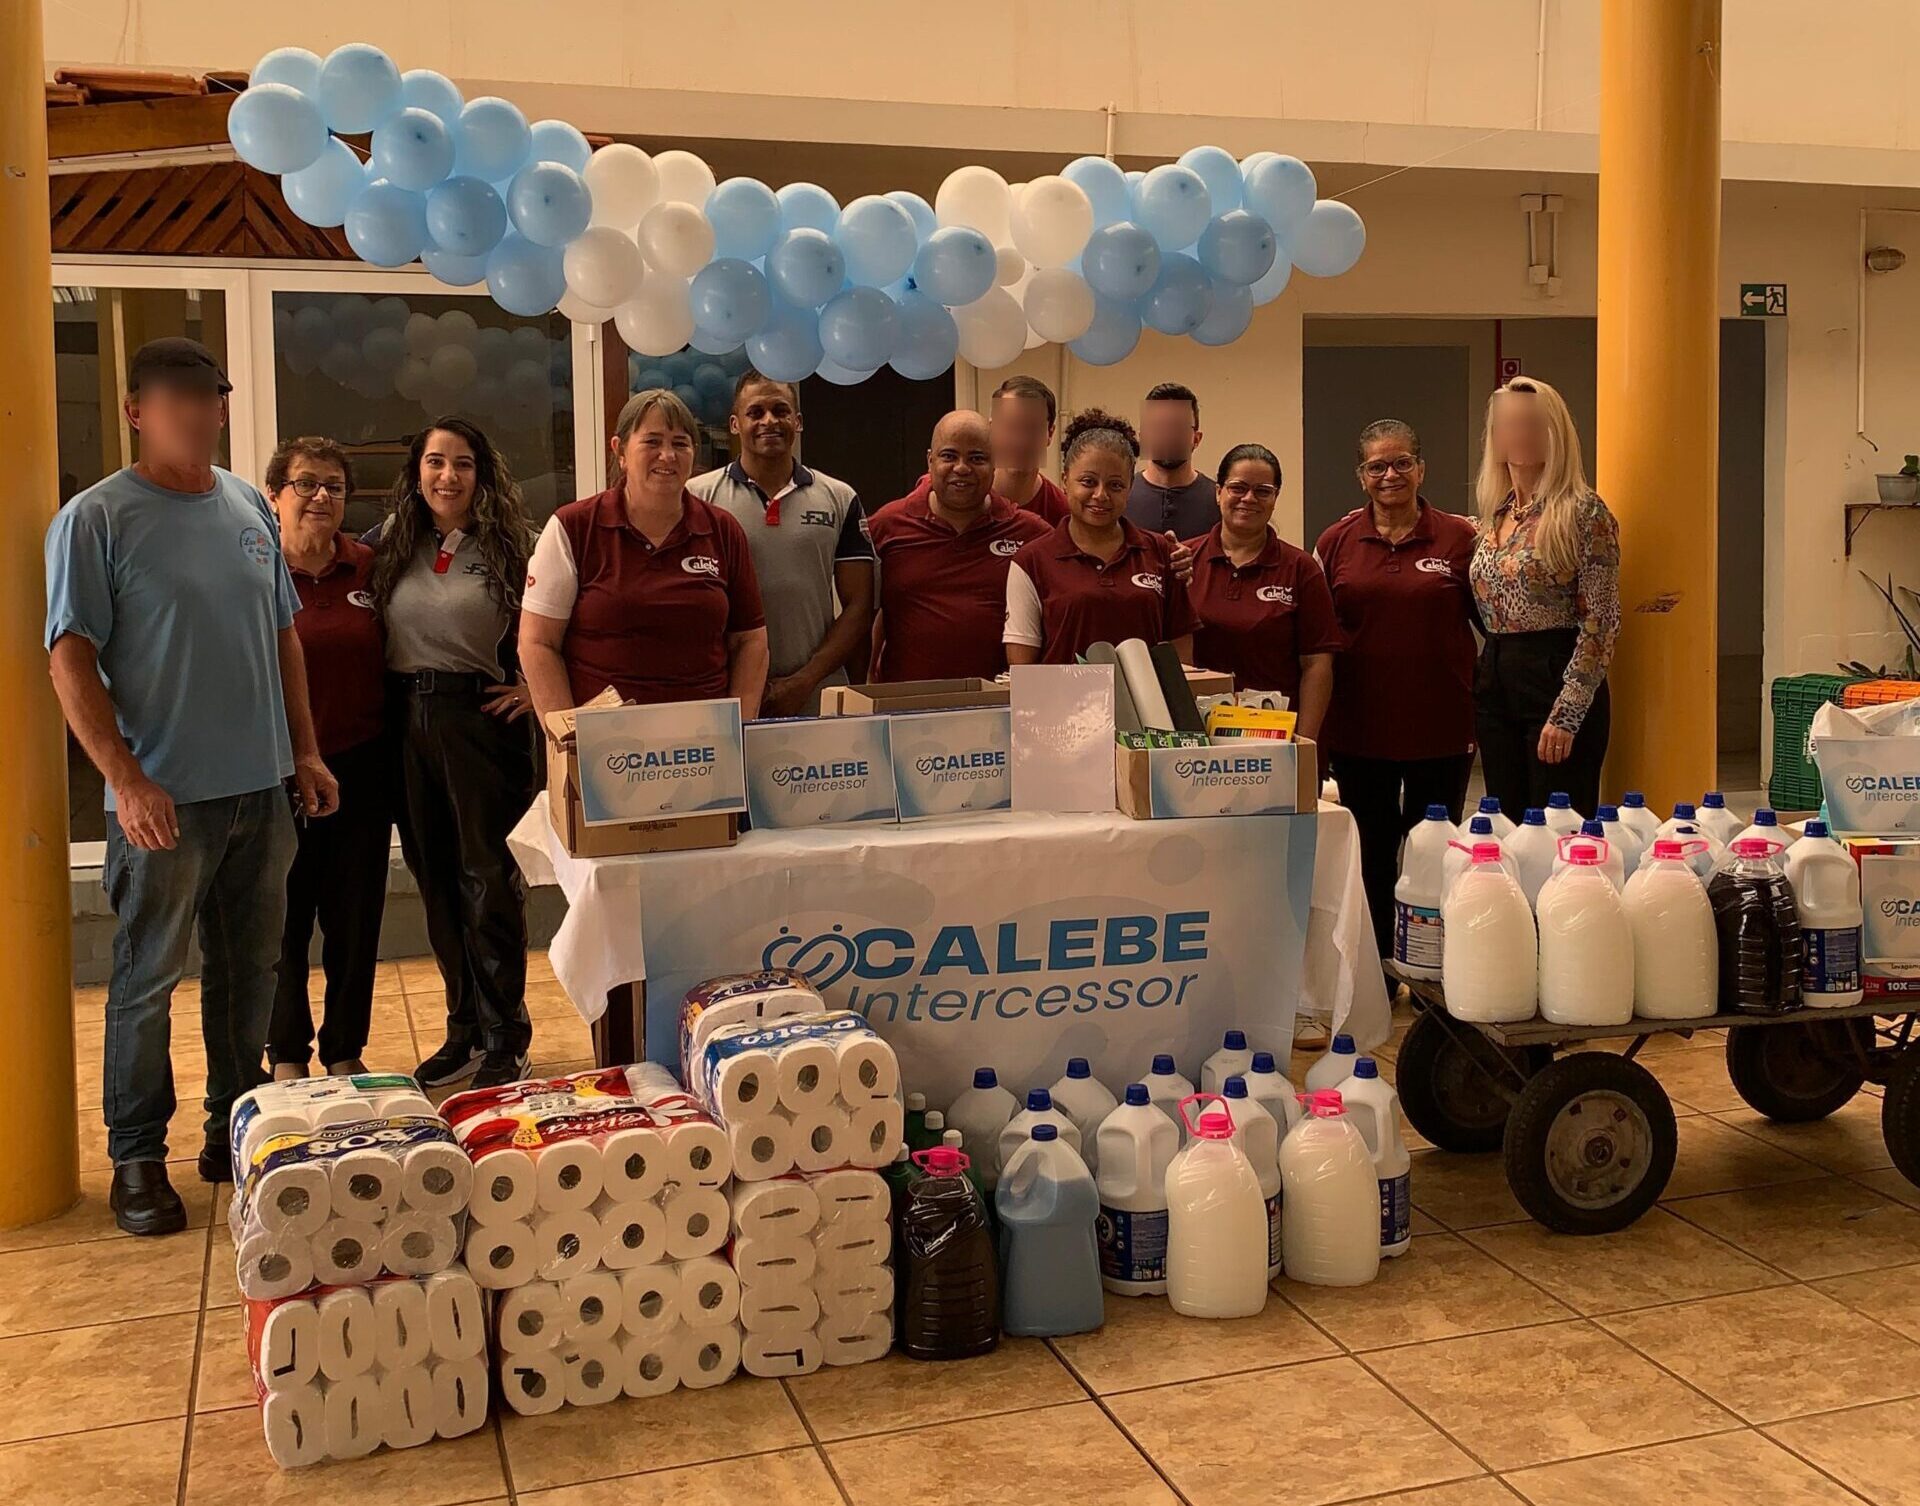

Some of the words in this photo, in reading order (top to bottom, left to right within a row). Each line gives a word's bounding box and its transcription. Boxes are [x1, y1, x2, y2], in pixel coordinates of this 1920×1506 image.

[627, 746, 716, 769] CALEBE
[933, 751, 1006, 771] CALEBE
[1193, 758, 1272, 775] CALEBE
[627, 765, 714, 783] Intercessor
[790, 761, 869, 781] CALEBE
[932, 768, 1004, 783] Intercessor
[790, 778, 868, 795] Intercessor
[1191, 774, 1271, 787] Intercessor
[851, 911, 1210, 980] CALEBE
[1887, 982, 1908, 991] 10X
[848, 972, 1199, 1023] Intercessor
